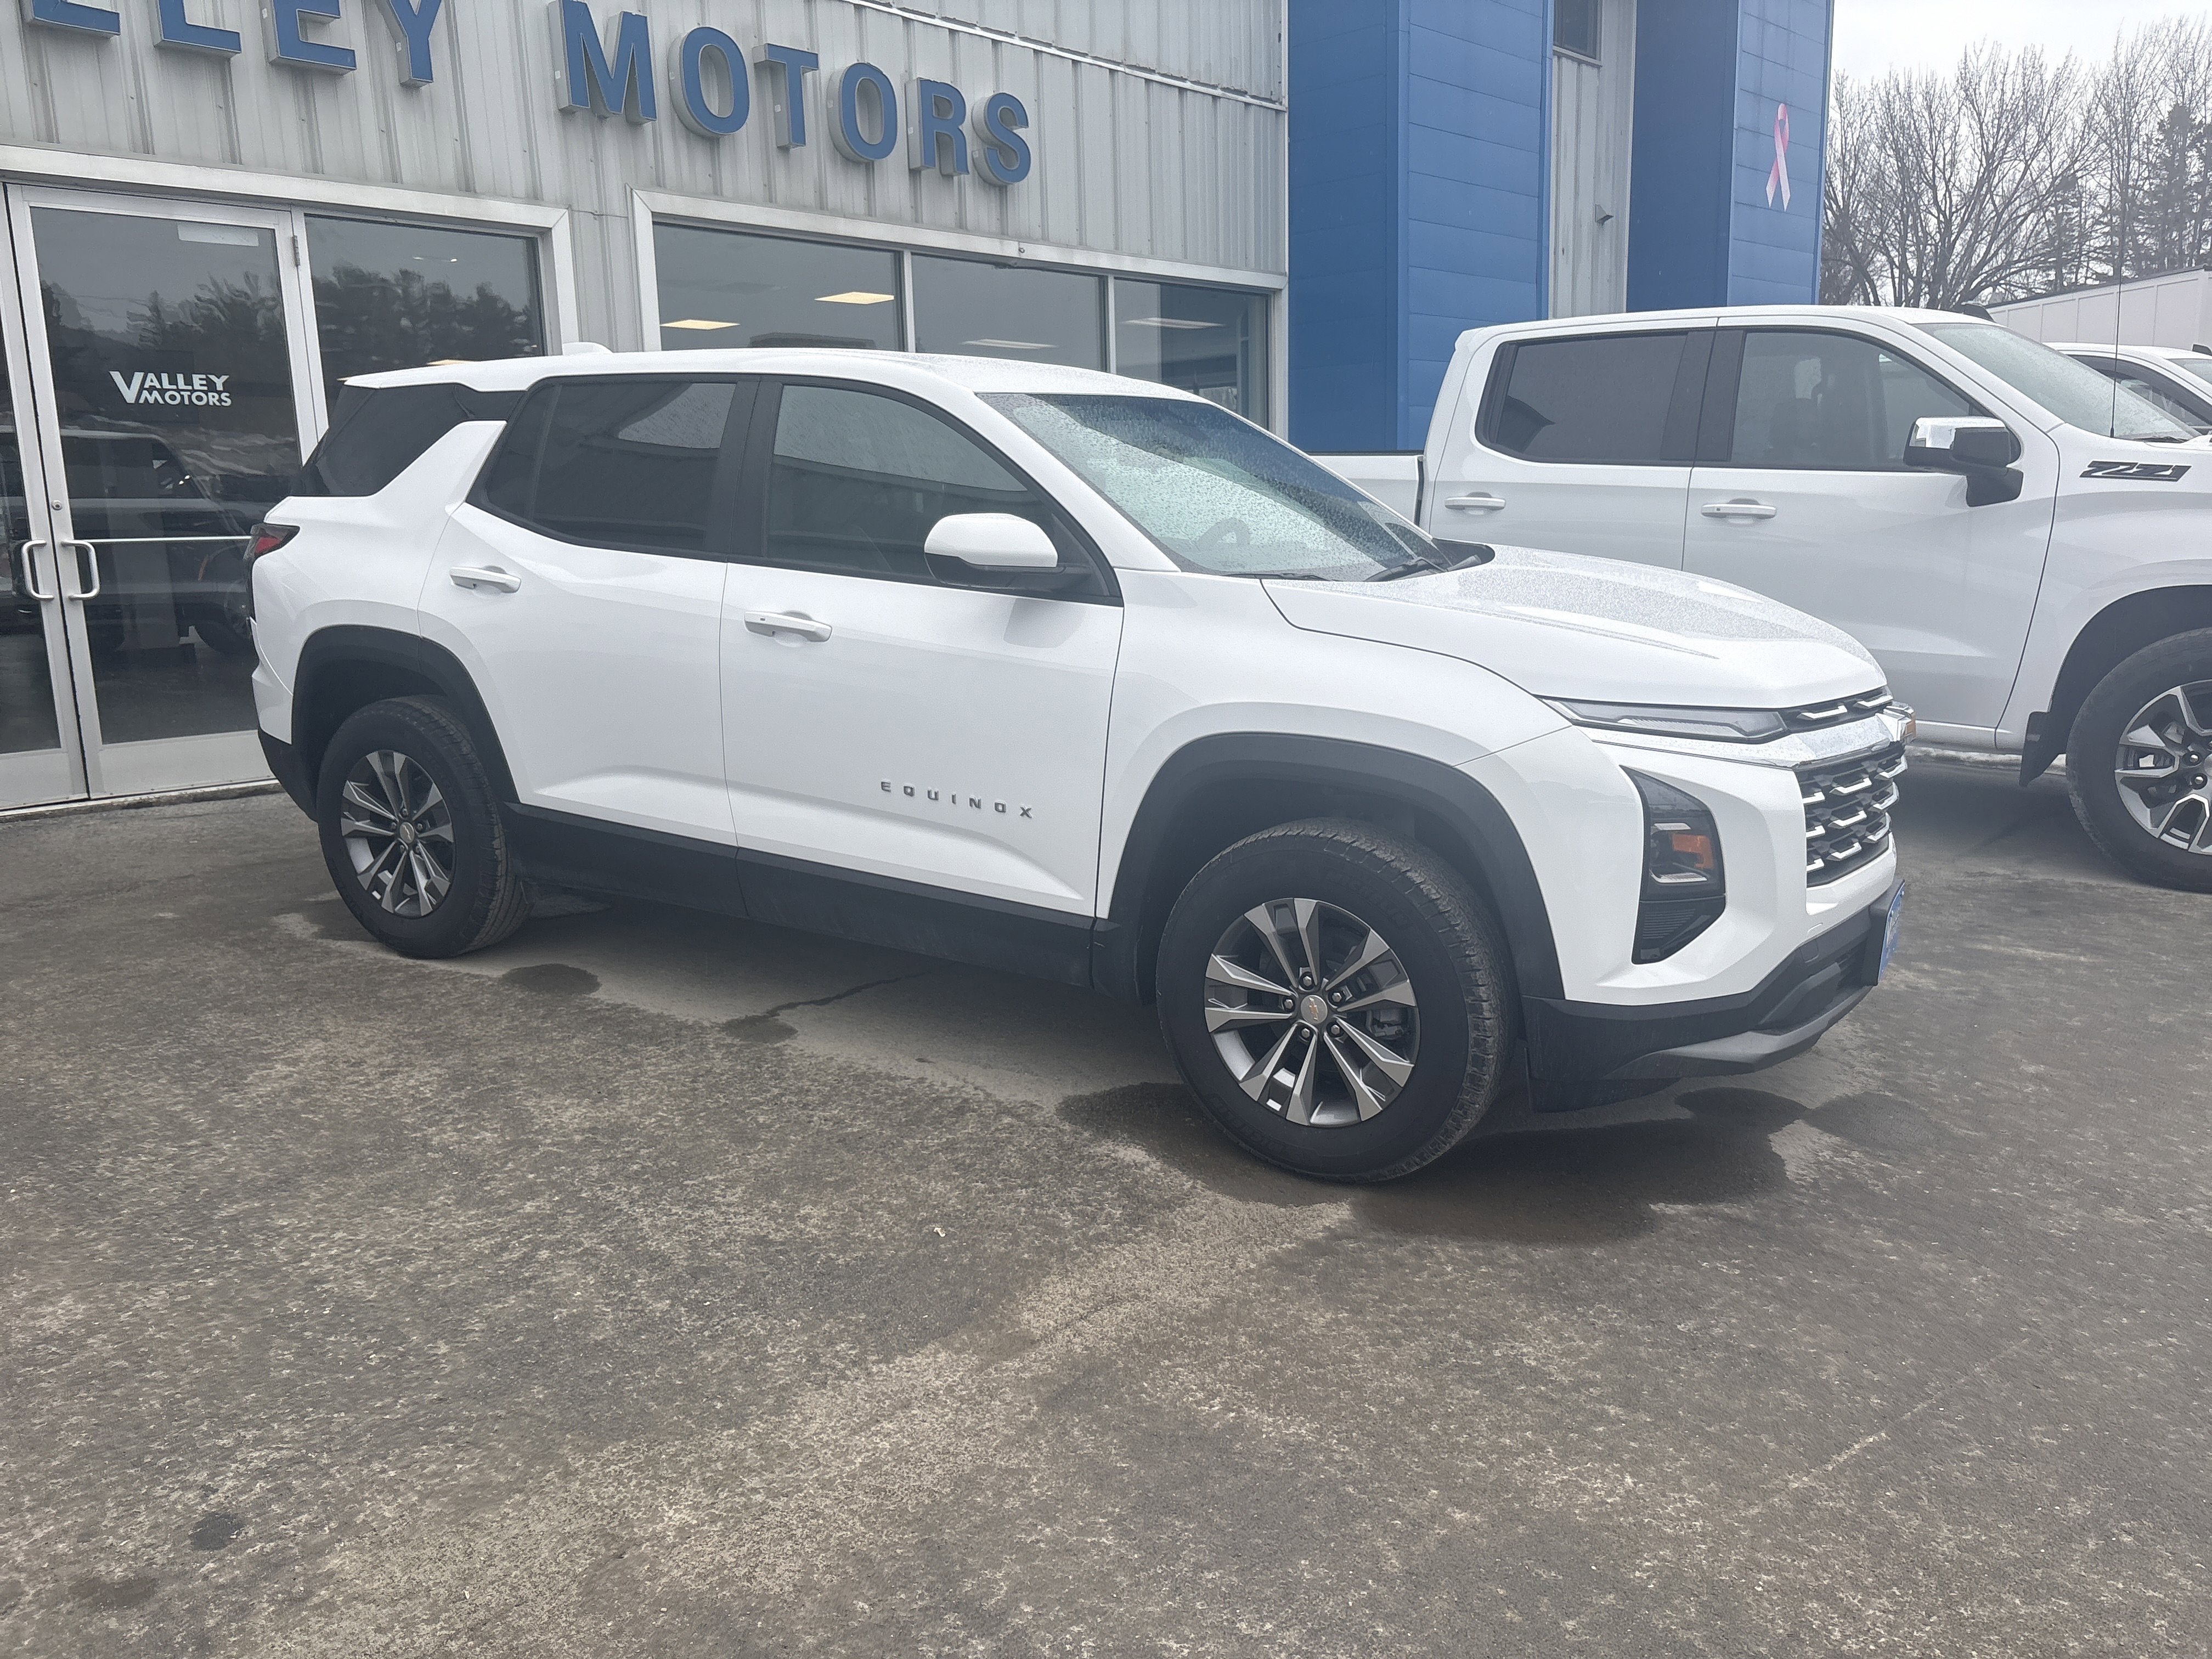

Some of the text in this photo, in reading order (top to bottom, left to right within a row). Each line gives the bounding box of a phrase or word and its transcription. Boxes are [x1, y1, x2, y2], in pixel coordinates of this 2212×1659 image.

[26, 0, 1031, 185] EY MOTORS
[109, 371, 229, 404] VALLEY
[138, 390, 232, 407] MOTORS
[2079, 460, 2192, 482] Z71
[881, 779, 1032, 819] EQUINOX
